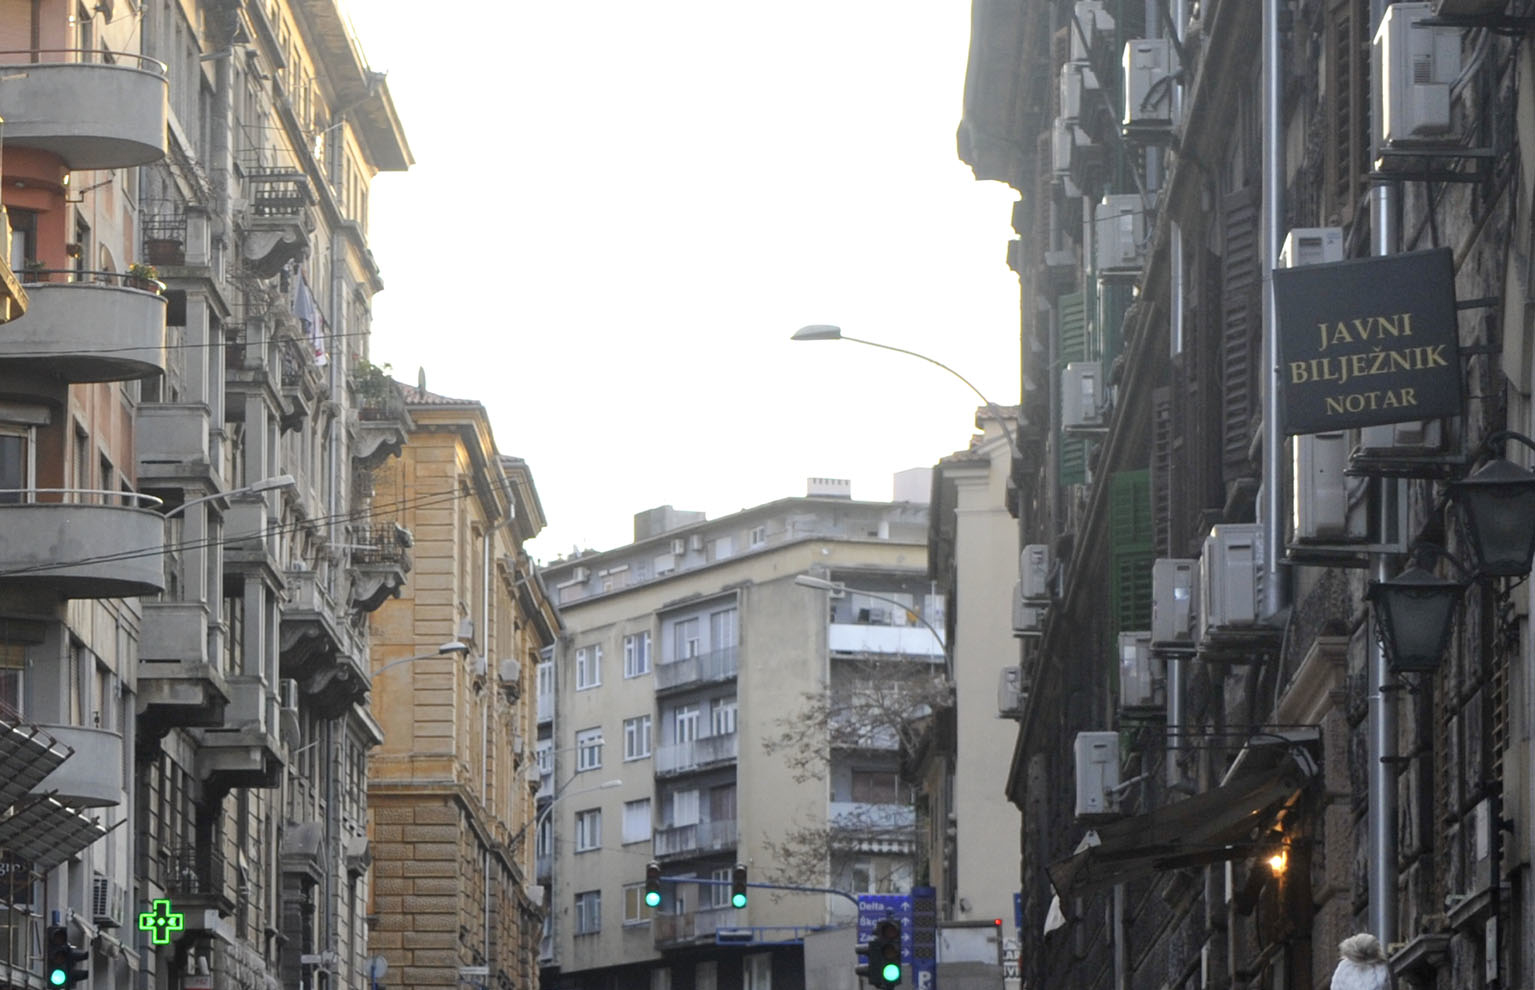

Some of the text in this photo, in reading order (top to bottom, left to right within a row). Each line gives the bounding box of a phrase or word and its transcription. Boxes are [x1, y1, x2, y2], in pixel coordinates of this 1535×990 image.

[1317, 313, 1413, 351] JAVNI
[1289, 344, 1448, 385] BILJEŽNIK
[1324, 387, 1418, 416] NOTAR
[859, 901, 884, 911] Delta
